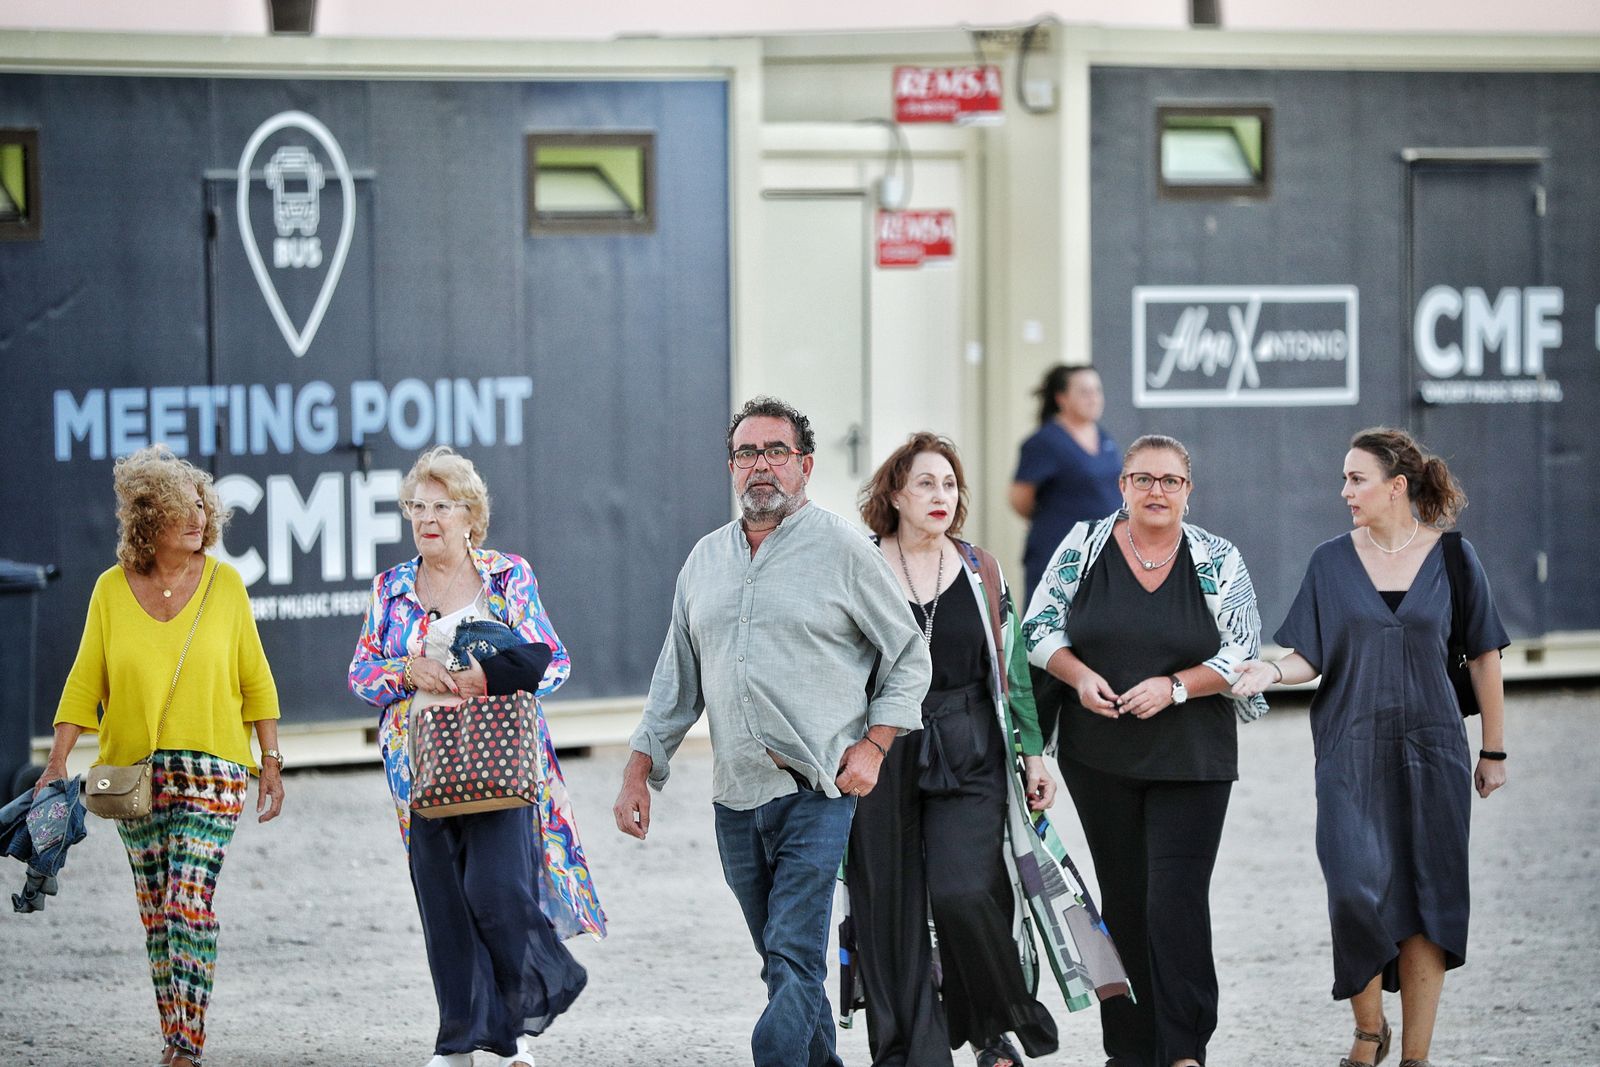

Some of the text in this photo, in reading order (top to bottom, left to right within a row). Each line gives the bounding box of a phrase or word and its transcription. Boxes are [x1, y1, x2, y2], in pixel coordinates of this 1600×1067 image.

[273, 237, 322, 269] BUS
[1414, 285, 1564, 378] CMF
[54, 376, 533, 461] MEETING POINT
[213, 471, 403, 586] CMF
[278, 593, 331, 619] MUSIC
